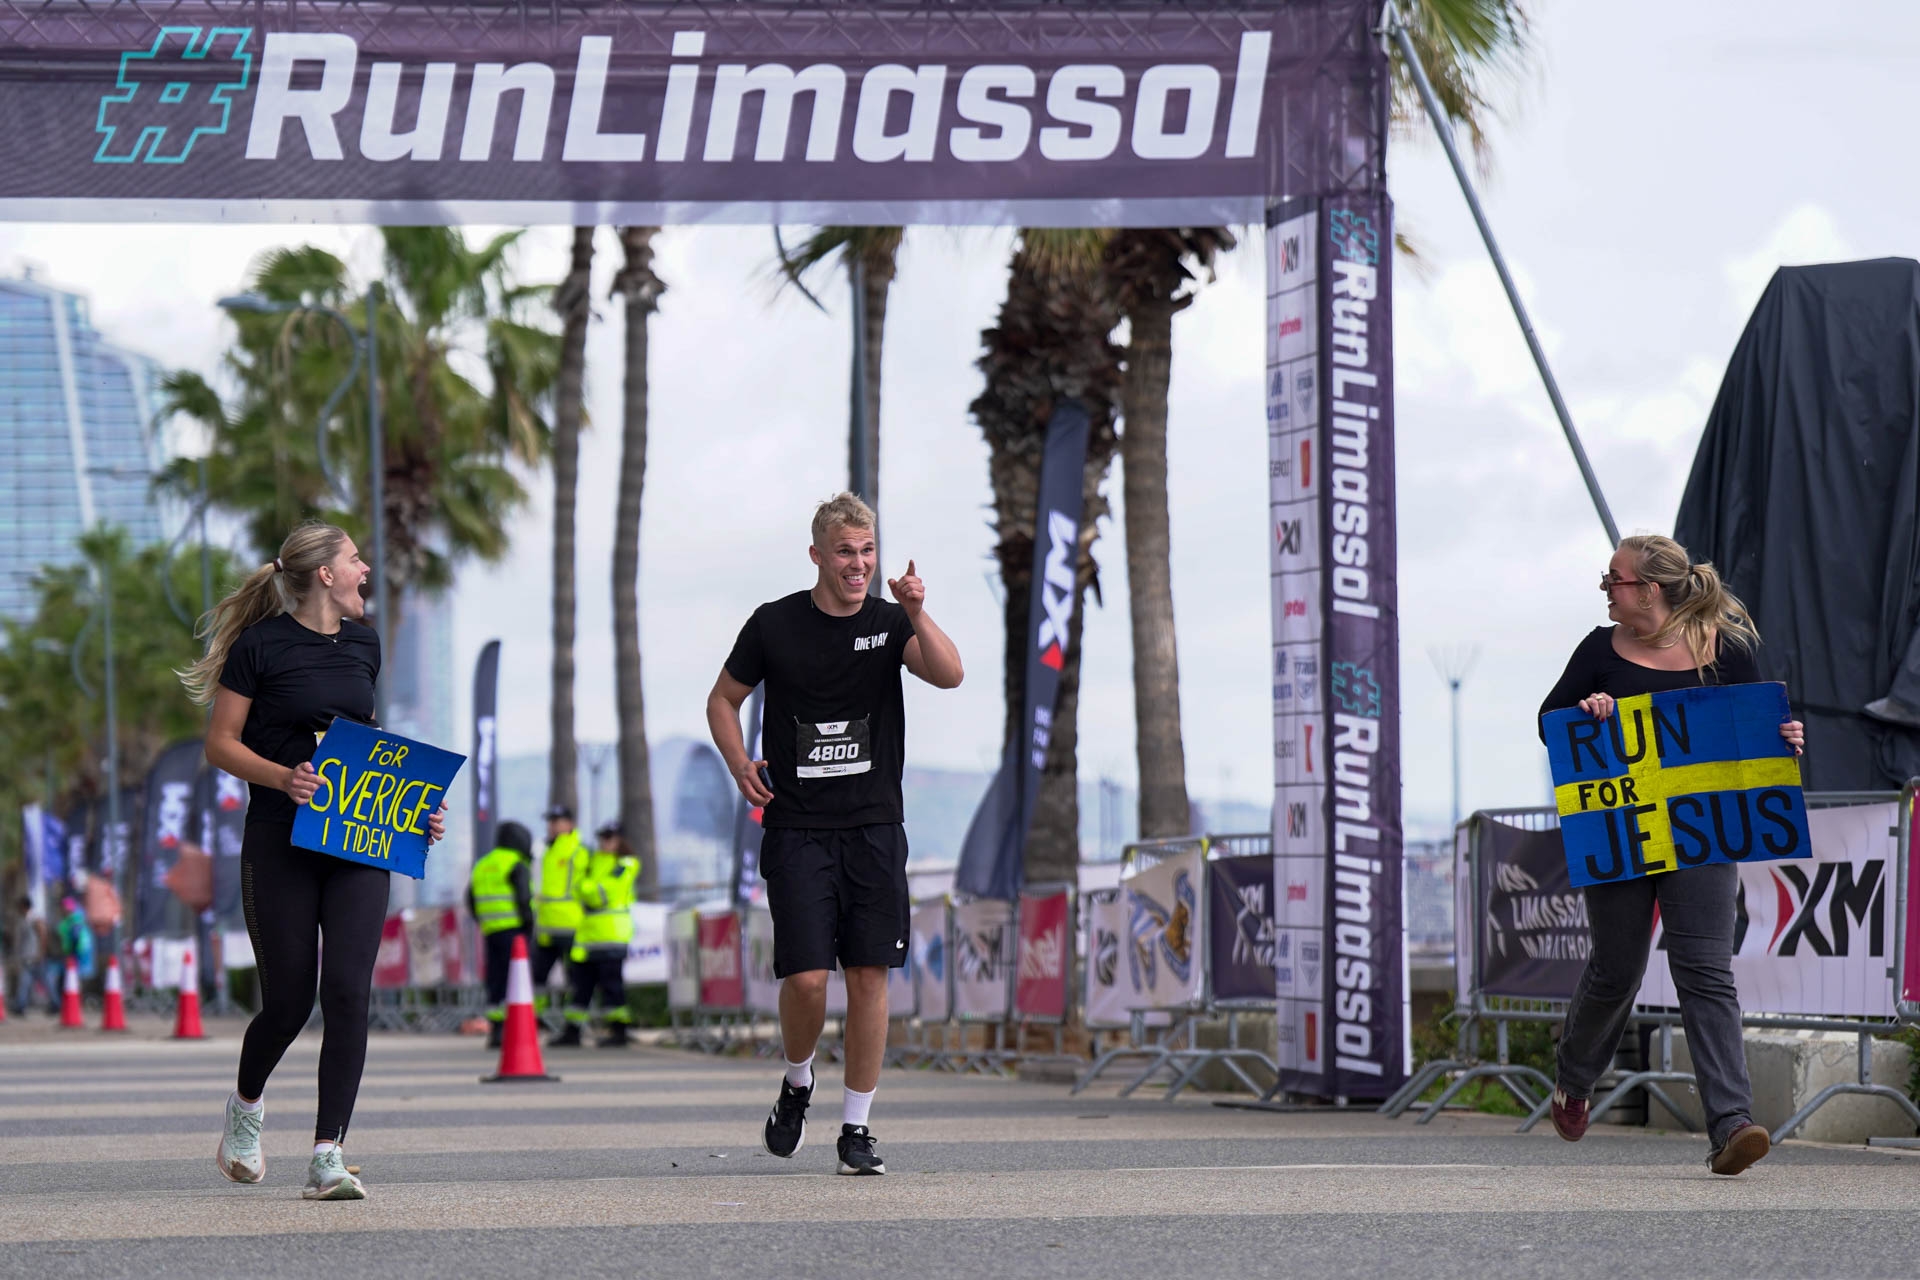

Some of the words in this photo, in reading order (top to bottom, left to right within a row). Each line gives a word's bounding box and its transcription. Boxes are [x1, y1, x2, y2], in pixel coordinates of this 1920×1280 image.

[93, 26, 1273, 164] #RunLimassol
[1330, 209, 1379, 619] #RunLimassol
[1038, 510, 1078, 651] XM
[854, 636, 871, 651] ONE
[871, 632, 889, 649] WAY
[808, 743, 860, 762] 4800
[1566, 703, 1691, 773] RUN
[309, 757, 443, 835] SVERIGE
[1577, 776, 1640, 811] FOR
[322, 817, 330, 846] I
[343, 820, 394, 859] TIDEN
[1331, 661, 1383, 1077] #RunLimassol
[1585, 789, 1799, 881] JESUS
[1510, 893, 1590, 930] LIMASSOL
[1777, 859, 1885, 957] XM
